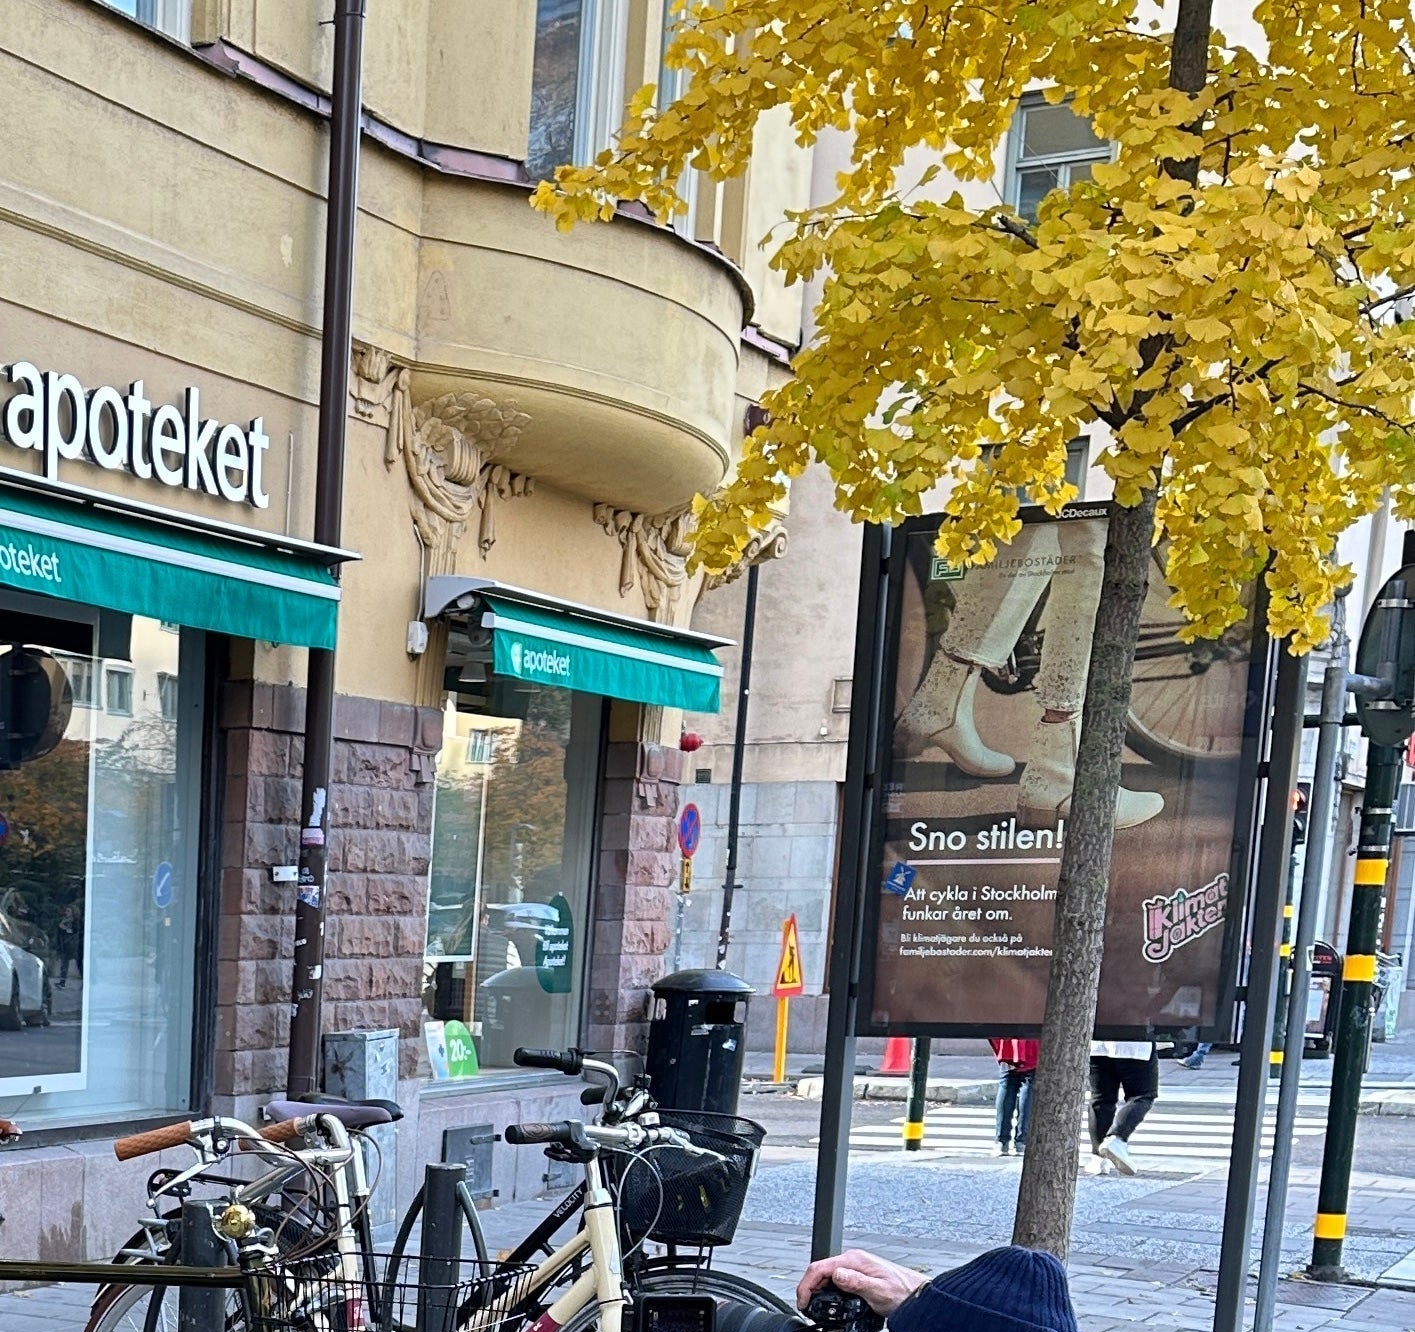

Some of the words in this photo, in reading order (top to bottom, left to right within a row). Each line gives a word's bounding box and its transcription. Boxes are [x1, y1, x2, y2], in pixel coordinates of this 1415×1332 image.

[4, 361, 270, 509] apoteket
[523, 649, 571, 677] apoteket
[909, 821, 967, 851] Sno
[976, 818, 1064, 850] stilen!
[904, 887, 926, 901] Att
[929, 885, 968, 905] cykla
[972, 887, 977, 901] i
[902, 905, 949, 921] funkar
[952, 906, 982, 921] året
[985, 909, 1013, 921] om.
[900, 933, 911, 943] Bli
[912, 933, 967, 944] klimatjägare
[969, 933, 980, 943] du
[982, 932, 1008, 943] också
[1010, 932, 1023, 945] på
[553, 1187, 583, 1218] VELOCITY
